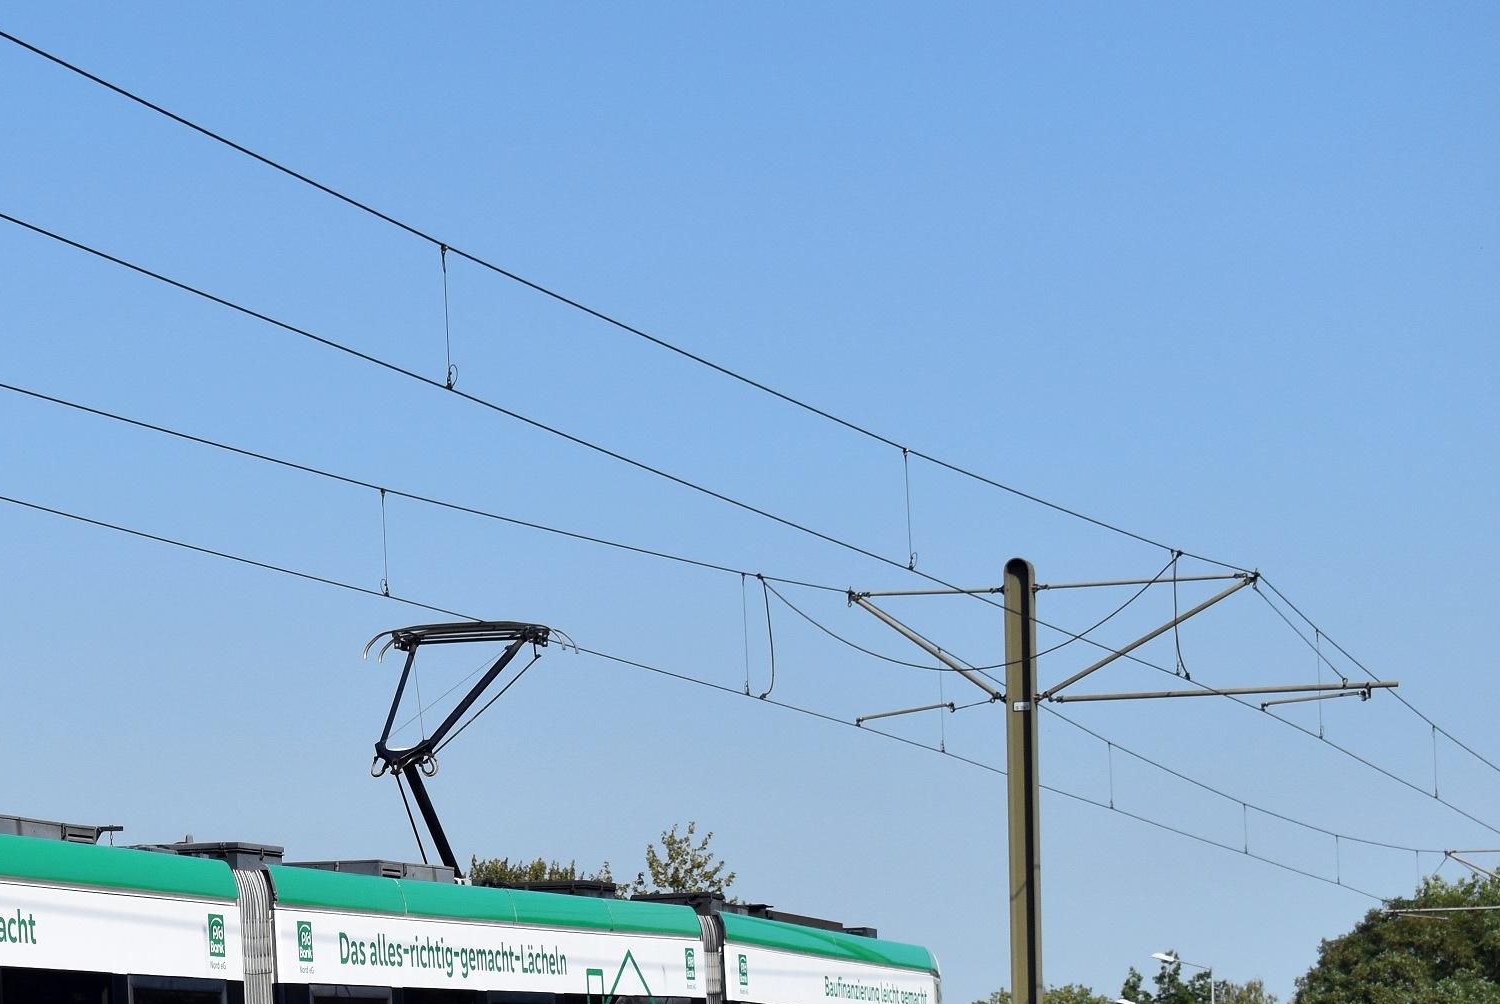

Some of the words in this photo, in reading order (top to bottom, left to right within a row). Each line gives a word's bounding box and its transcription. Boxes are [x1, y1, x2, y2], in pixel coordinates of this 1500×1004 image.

[211, 941, 225, 954] Bank
[300, 947, 313, 959] Bank
[338, 932, 366, 965] Das
[370, 933, 567, 978] alles-richtig-gemacht-Lächeln
[880, 981, 900, 1004] leicht
